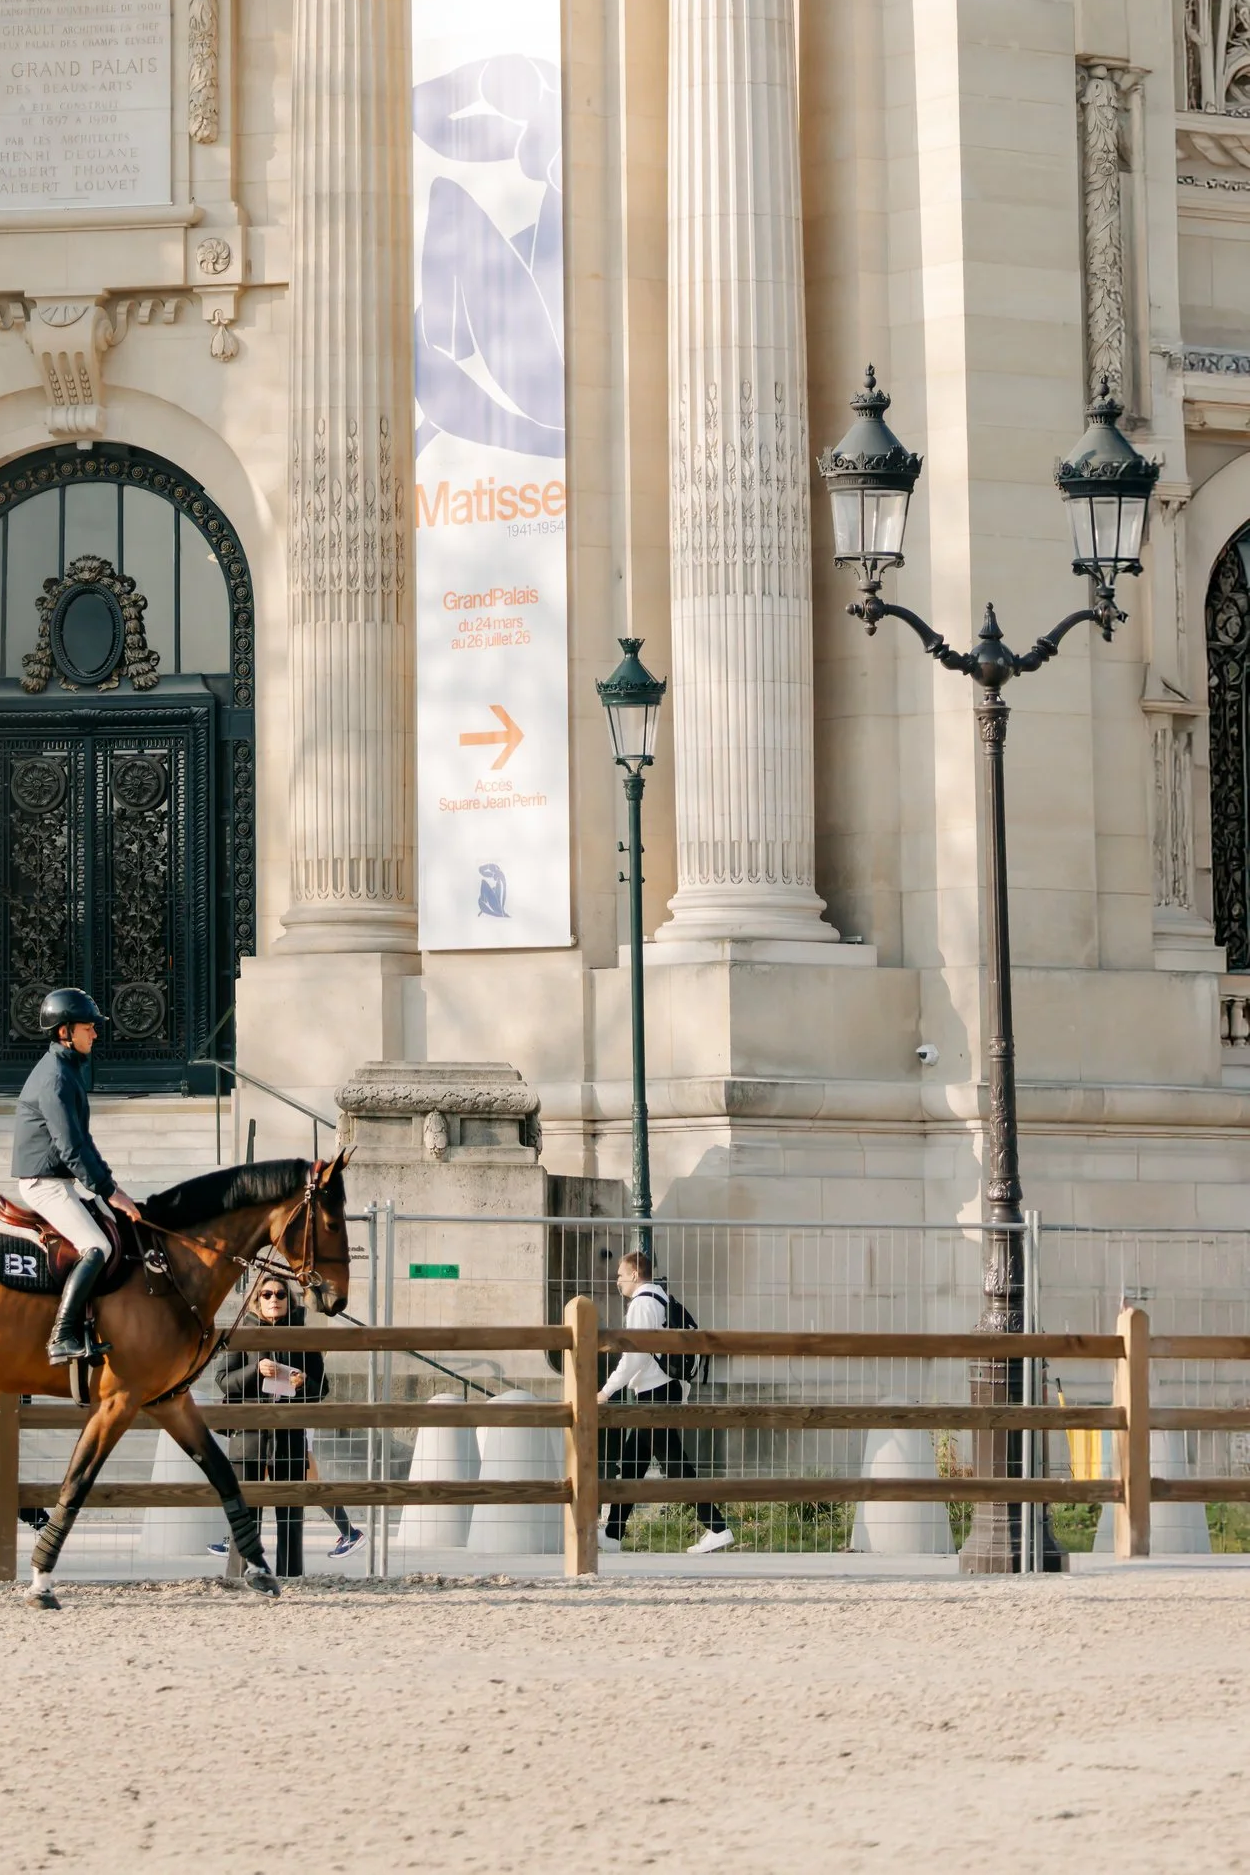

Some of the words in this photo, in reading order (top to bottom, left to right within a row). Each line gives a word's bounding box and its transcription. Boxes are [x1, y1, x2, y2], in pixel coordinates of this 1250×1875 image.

[120, 3, 134, 13] DE
[137, 2, 162, 12] 1900
[2, 24, 56, 37] GIRAULT
[136, 22, 160, 32] CHEF
[25, 40, 56, 50] PALAIS
[59, 39, 78, 49] DES
[82, 37, 119, 48] CHAMPS
[11, 60, 81, 78] GRAND
[92, 57, 158, 75] PALAIS
[6, 84, 31, 95] DES
[43, 80, 134, 94] BEAUX-ARTS
[59, 100, 120, 111] CONSTRUIT
[21, 117, 34, 126] DE
[42, 115, 69, 126] 1897
[89, 114, 118, 124] 1900
[5, 136, 25, 146] PAR
[33, 135, 51, 145] LES
[60, 132, 131, 145] ARCHITECTES
[0, 150, 51, 163] HENRI
[64, 147, 140, 161] DEGLANE
[72, 163, 141, 177] THOMAS
[75, 178, 138, 192] LOUVET
[415, 476, 567, 529] Matisse
[507, 520, 565, 538] 1941-1954
[442, 585, 539, 611] GrandPalais
[458, 619, 474, 633] du
[475, 616, 492, 632] 24
[493, 617, 524, 630] mars
[451, 638, 466, 650] au
[466, 634, 483, 649] 26
[483, 632, 513, 650] juillet
[515, 630, 531, 645] 26
[474, 778, 513, 794] Accès
[439, 796, 481, 814] Square
[481, 794, 511, 810] Jean
[512, 791, 547, 808] Perrin
[10, 1253, 37, 1277] BR
